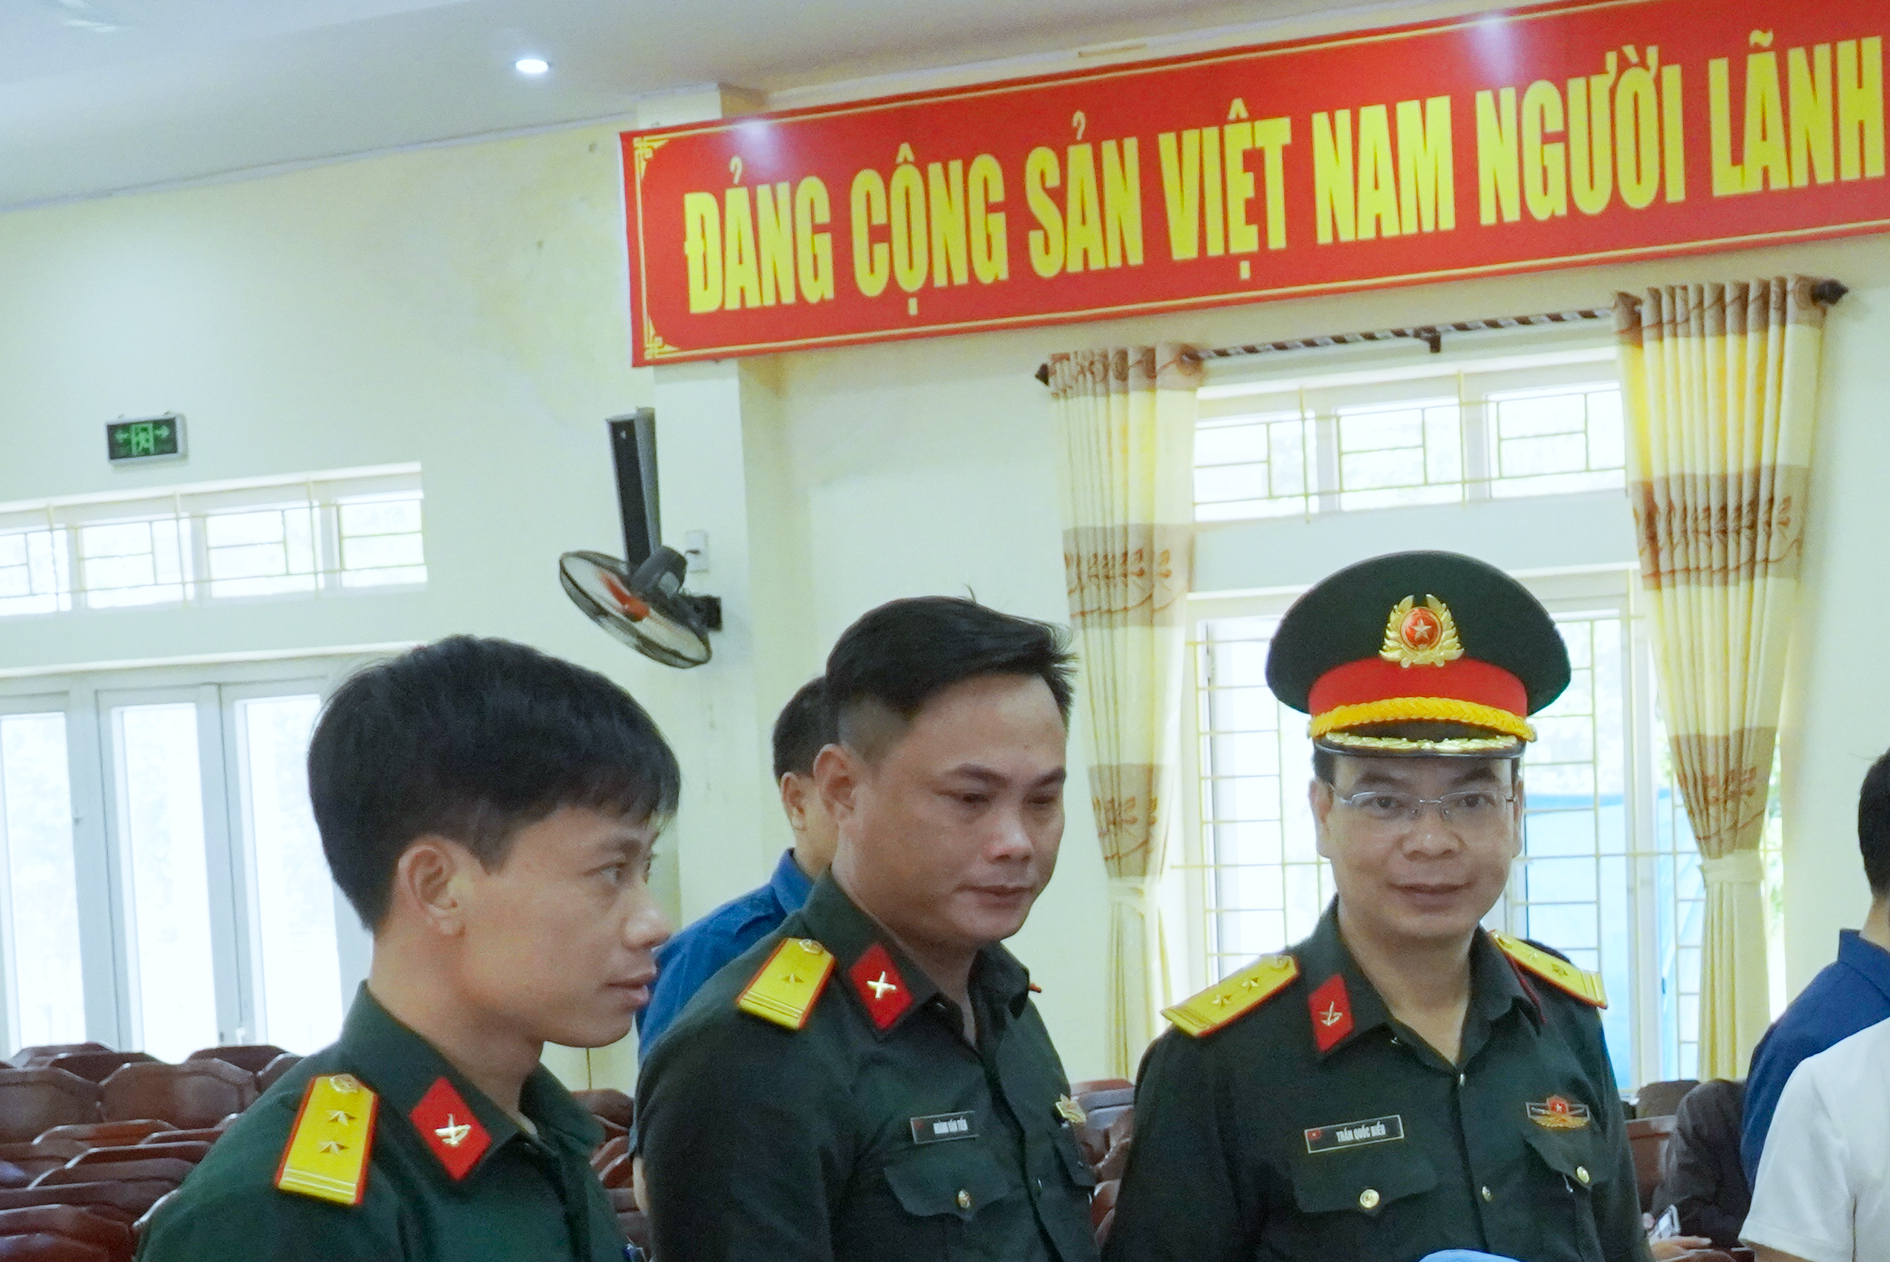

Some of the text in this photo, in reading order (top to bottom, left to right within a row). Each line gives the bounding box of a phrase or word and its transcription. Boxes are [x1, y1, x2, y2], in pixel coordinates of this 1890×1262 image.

[683, 156, 834, 315] ĐẢNG
[850, 143, 1009, 316] CỘNG
[1024, 111, 1144, 280] SẢN
[1158, 98, 1292, 281] VIỆT
[1312, 94, 1456, 246] NAM
[1475, 45, 1687, 227] NGƯỜI
[1707, 30, 1886, 199] LÃNH
